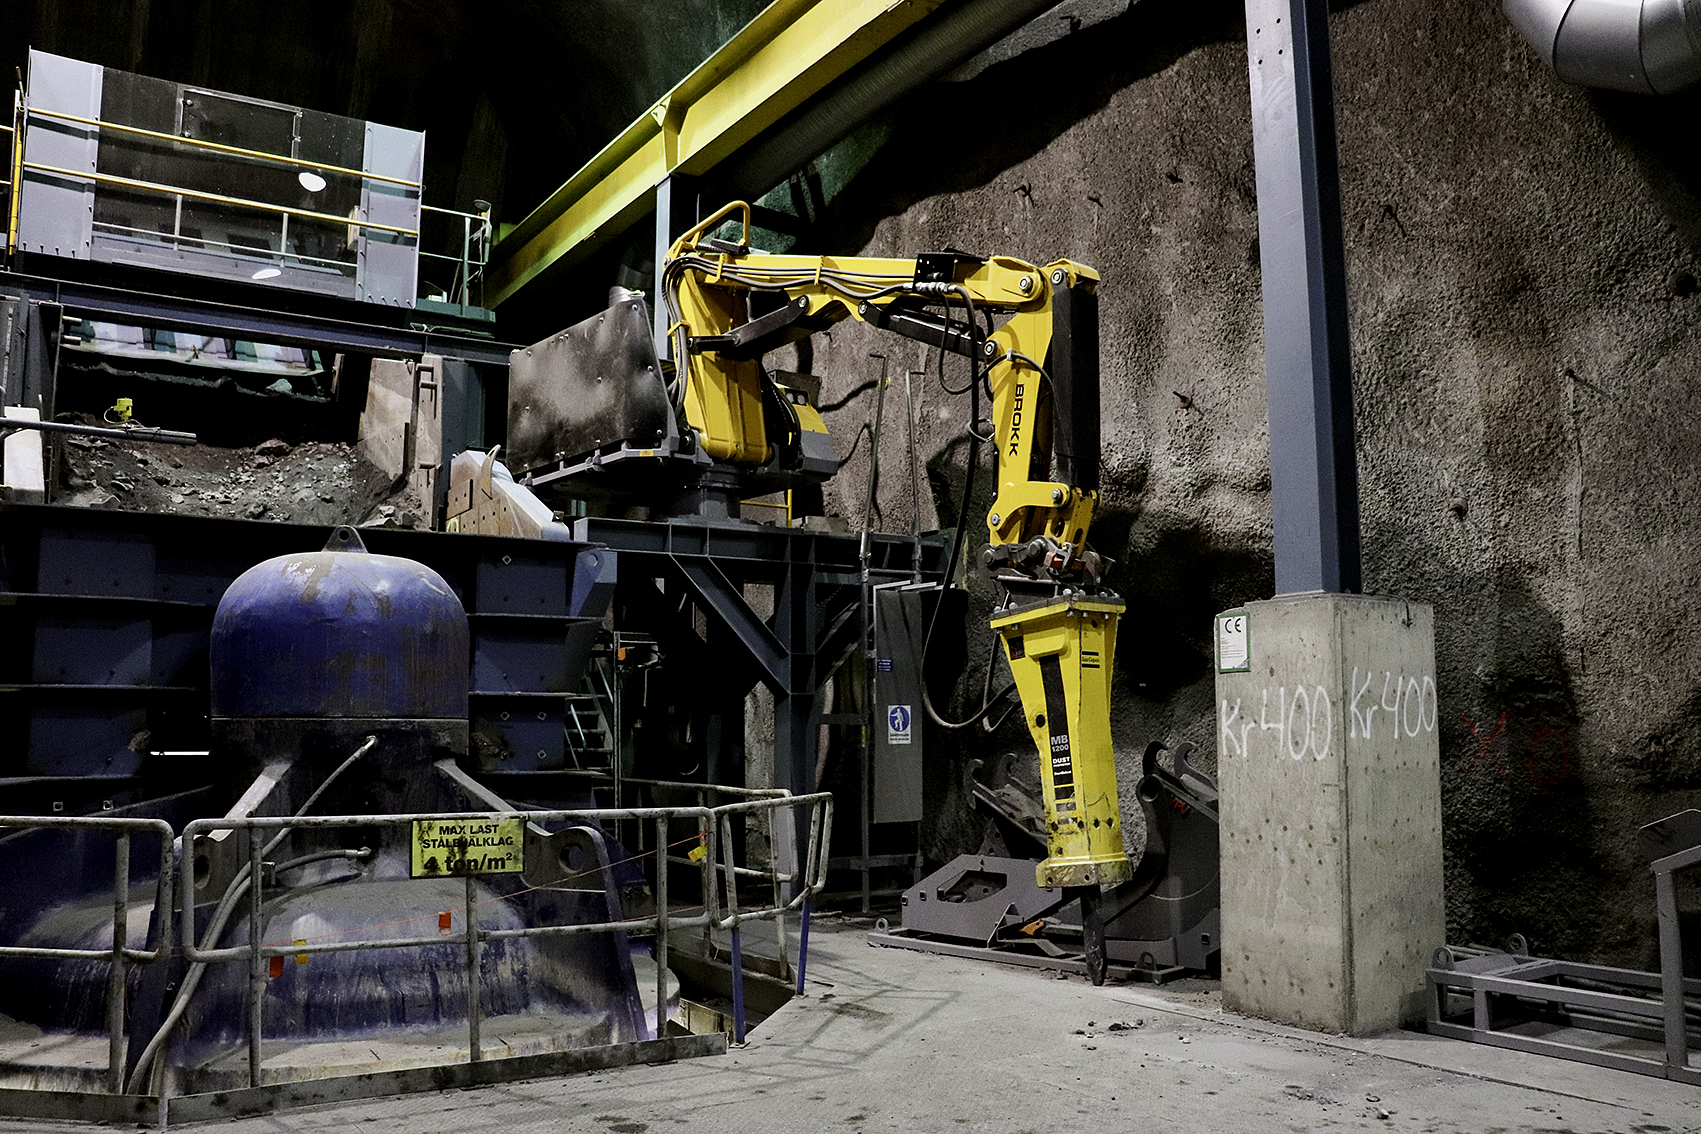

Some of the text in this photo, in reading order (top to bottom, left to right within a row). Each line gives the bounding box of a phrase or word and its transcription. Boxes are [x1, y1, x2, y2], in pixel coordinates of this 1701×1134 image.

[1009, 383, 1025, 457] BROKK
[1224, 617, 1242, 634] CE
[1050, 734, 1069, 746] MB
[1051, 744, 1069, 752] 1200
[1052, 756, 1071, 764] DUST
[439, 824, 499, 835] MAX LAST
[422, 836, 514, 849] STÅLBÄLKLAG
